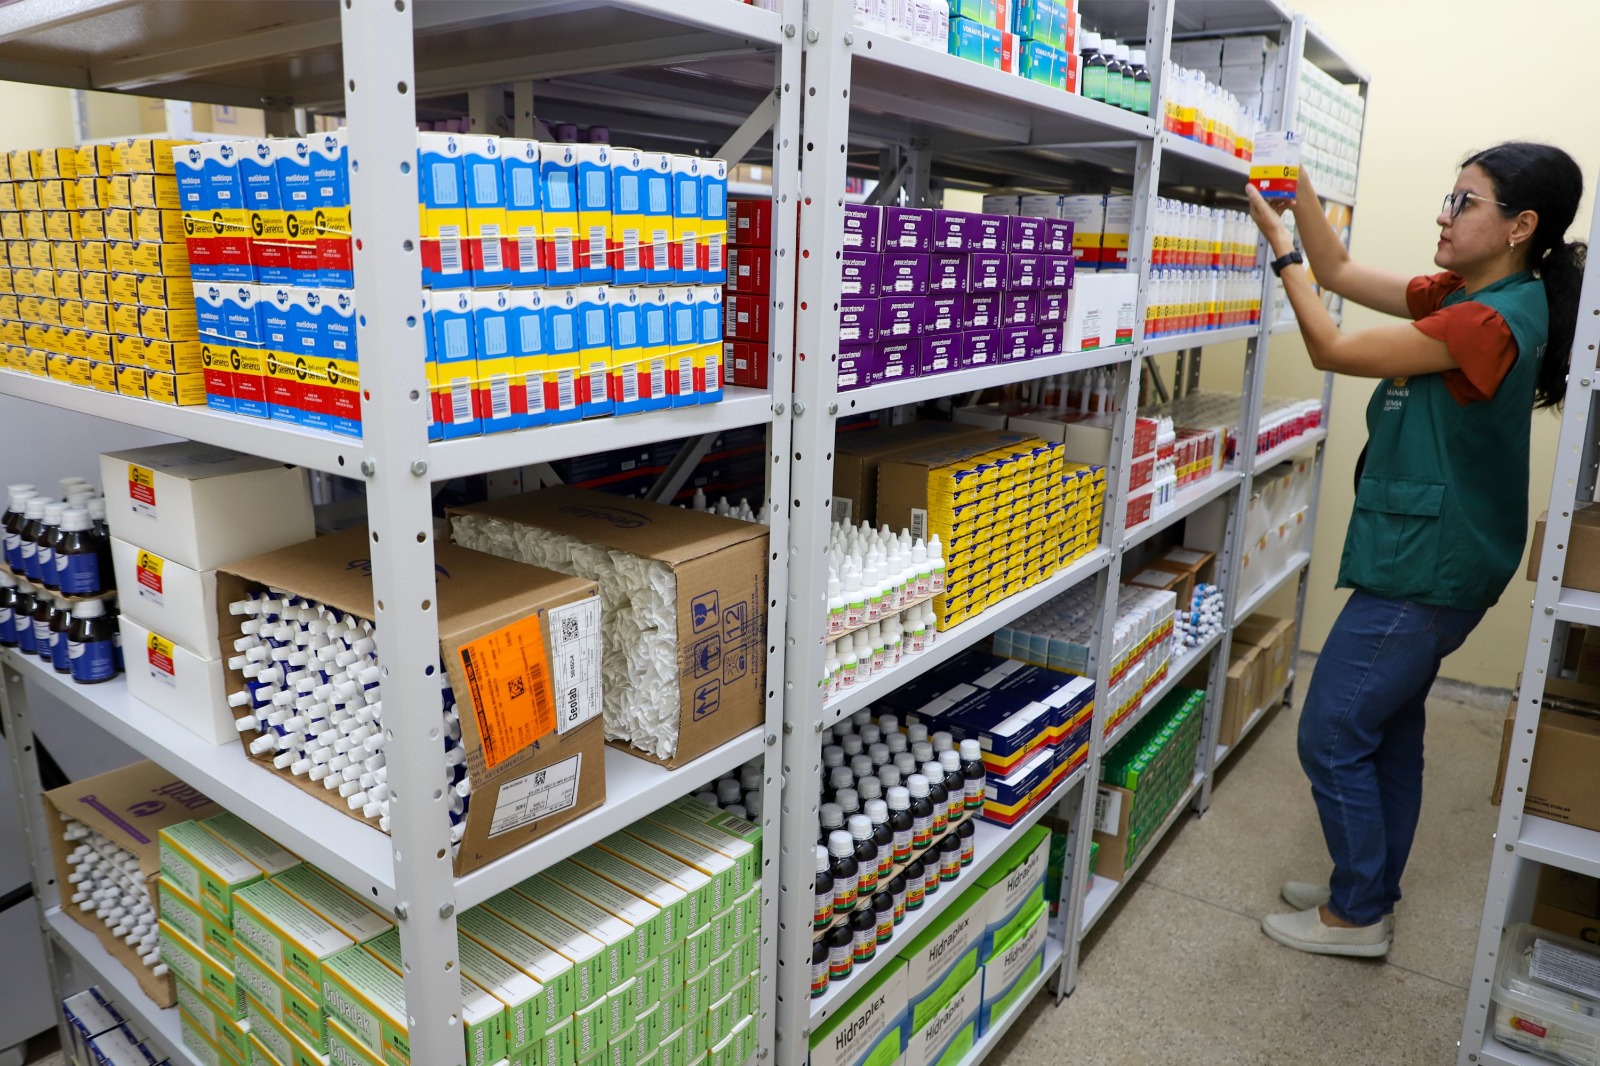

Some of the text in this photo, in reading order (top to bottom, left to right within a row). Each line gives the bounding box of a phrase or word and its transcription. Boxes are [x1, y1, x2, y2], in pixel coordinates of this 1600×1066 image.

[184, 213, 194, 235] G
[213, 212, 224, 234] G
[252, 213, 263, 236] G
[264, 224, 284, 234] Genérico
[287, 214, 299, 237] G
[300, 225, 314, 235] Genér
[315, 211, 326, 235] G
[891, 302, 914, 311] paracetamol
[934, 298, 954, 306] paracetamol
[202, 346, 212, 366] G
[884, 344, 907, 354] paracetamol
[931, 338, 952, 347] paracetamol
[230, 349, 241, 370] G
[241, 361, 260, 371] Genérico
[268, 353, 277, 375] G
[296, 357, 307, 380] G
[327, 361, 339, 384] G
[726, 609, 740, 638] 12
[569, 687, 577, 722] Geolab
[1007, 854, 1040, 892] Hidraplex
[688, 895, 696, 930] Colpadak
[637, 928, 645, 964] Colpadak
[929, 918, 969, 962] Hidraplex
[1004, 928, 1038, 967] Hidraplex
[610, 947, 618, 984] Colpadak
[688, 941, 696, 974] Colpadak
[580, 965, 588, 1003] Colpadak
[323, 980, 371, 1037] Colpadak
[546, 984, 554, 1023] Colpadak
[611, 999, 619, 1035] Colpadak
[688, 986, 696, 1018] Colpadak
[925, 994, 965, 1042] Hidraplex
[515, 1008, 524, 1048] Colpadak
[662, 1001, 670, 1036] Colpadak
[836, 995, 886, 1050] Hidraplex
[581, 1016, 589, 1055] Colpadak
[637, 1021, 645, 1057] Colpadak
[686, 1029, 694, 1061] Colpadak
